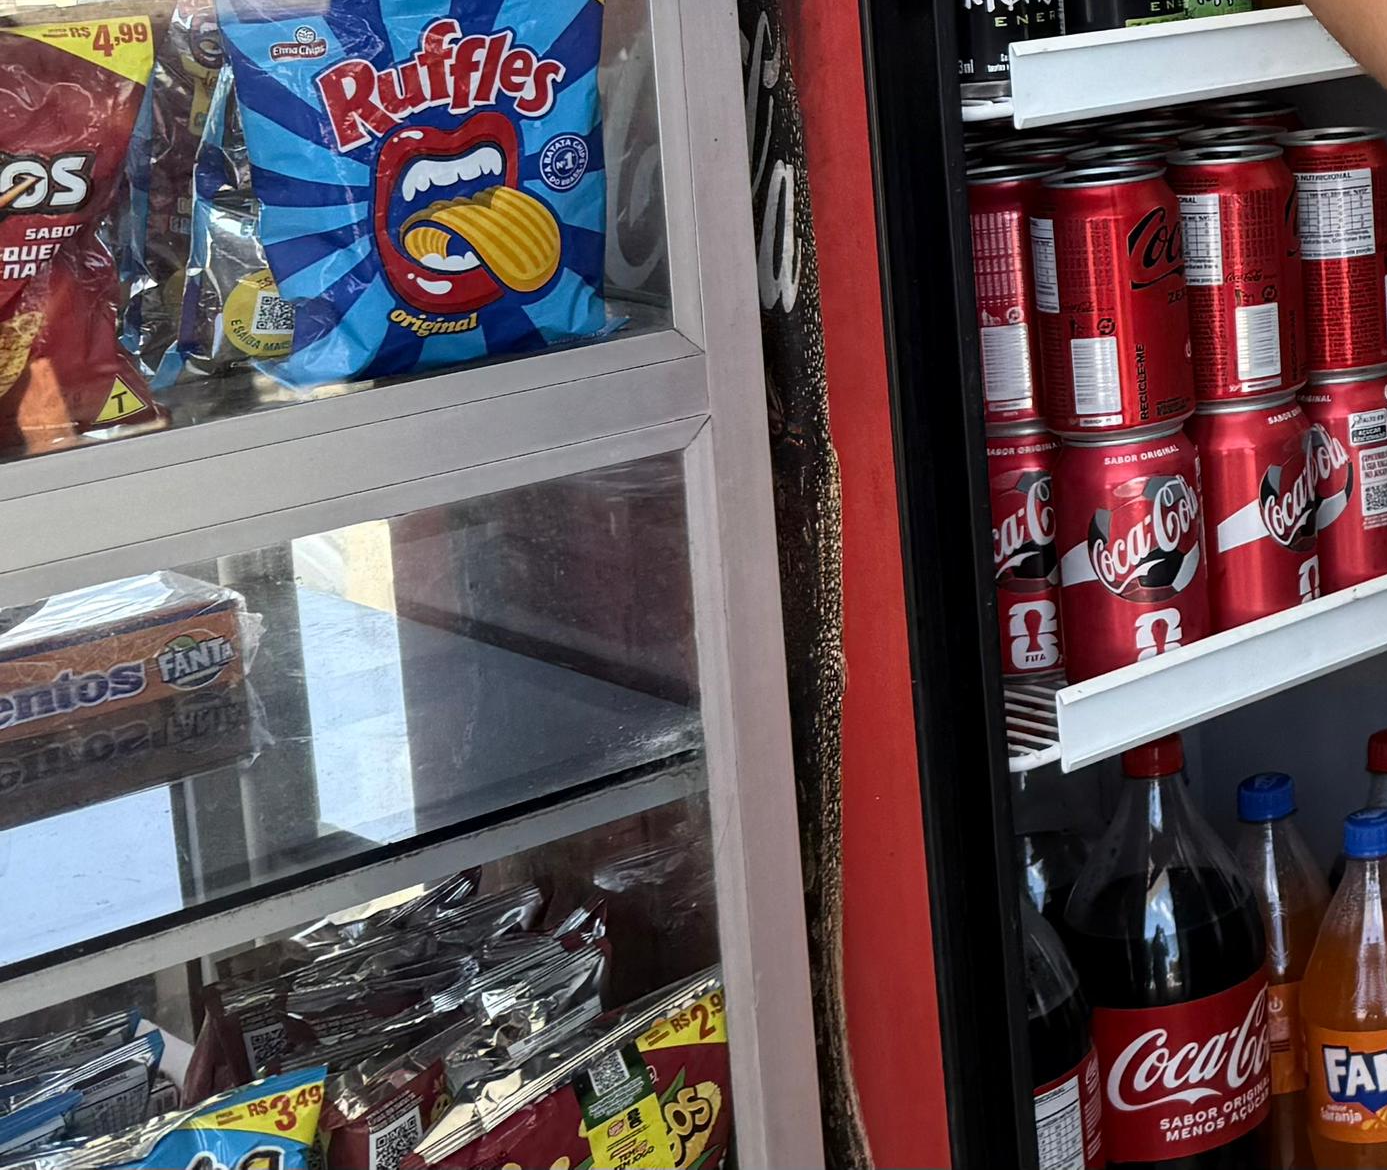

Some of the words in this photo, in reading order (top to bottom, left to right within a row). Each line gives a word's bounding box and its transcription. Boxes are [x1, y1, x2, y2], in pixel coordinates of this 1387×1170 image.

[70, 26, 91, 39] R$
[92, 22, 148, 57] 4,99
[317, 20, 564, 152] Ruffles
[1168, 290, 1187, 305] ZER
[1135, 343, 1148, 421] RECICLE-ME
[1104, 455, 1138, 466] SABOR
[1140, 444, 1180, 462] ORIGINAL
[158, 637, 234, 682] FANTA
[0, 661, 147, 732] entos
[249, 1097, 268, 1118] R$
[269, 1083, 322, 1132] 3,49
[1160, 1107, 1218, 1130] SABOR
[1166, 1118, 1226, 1142] MENOS
